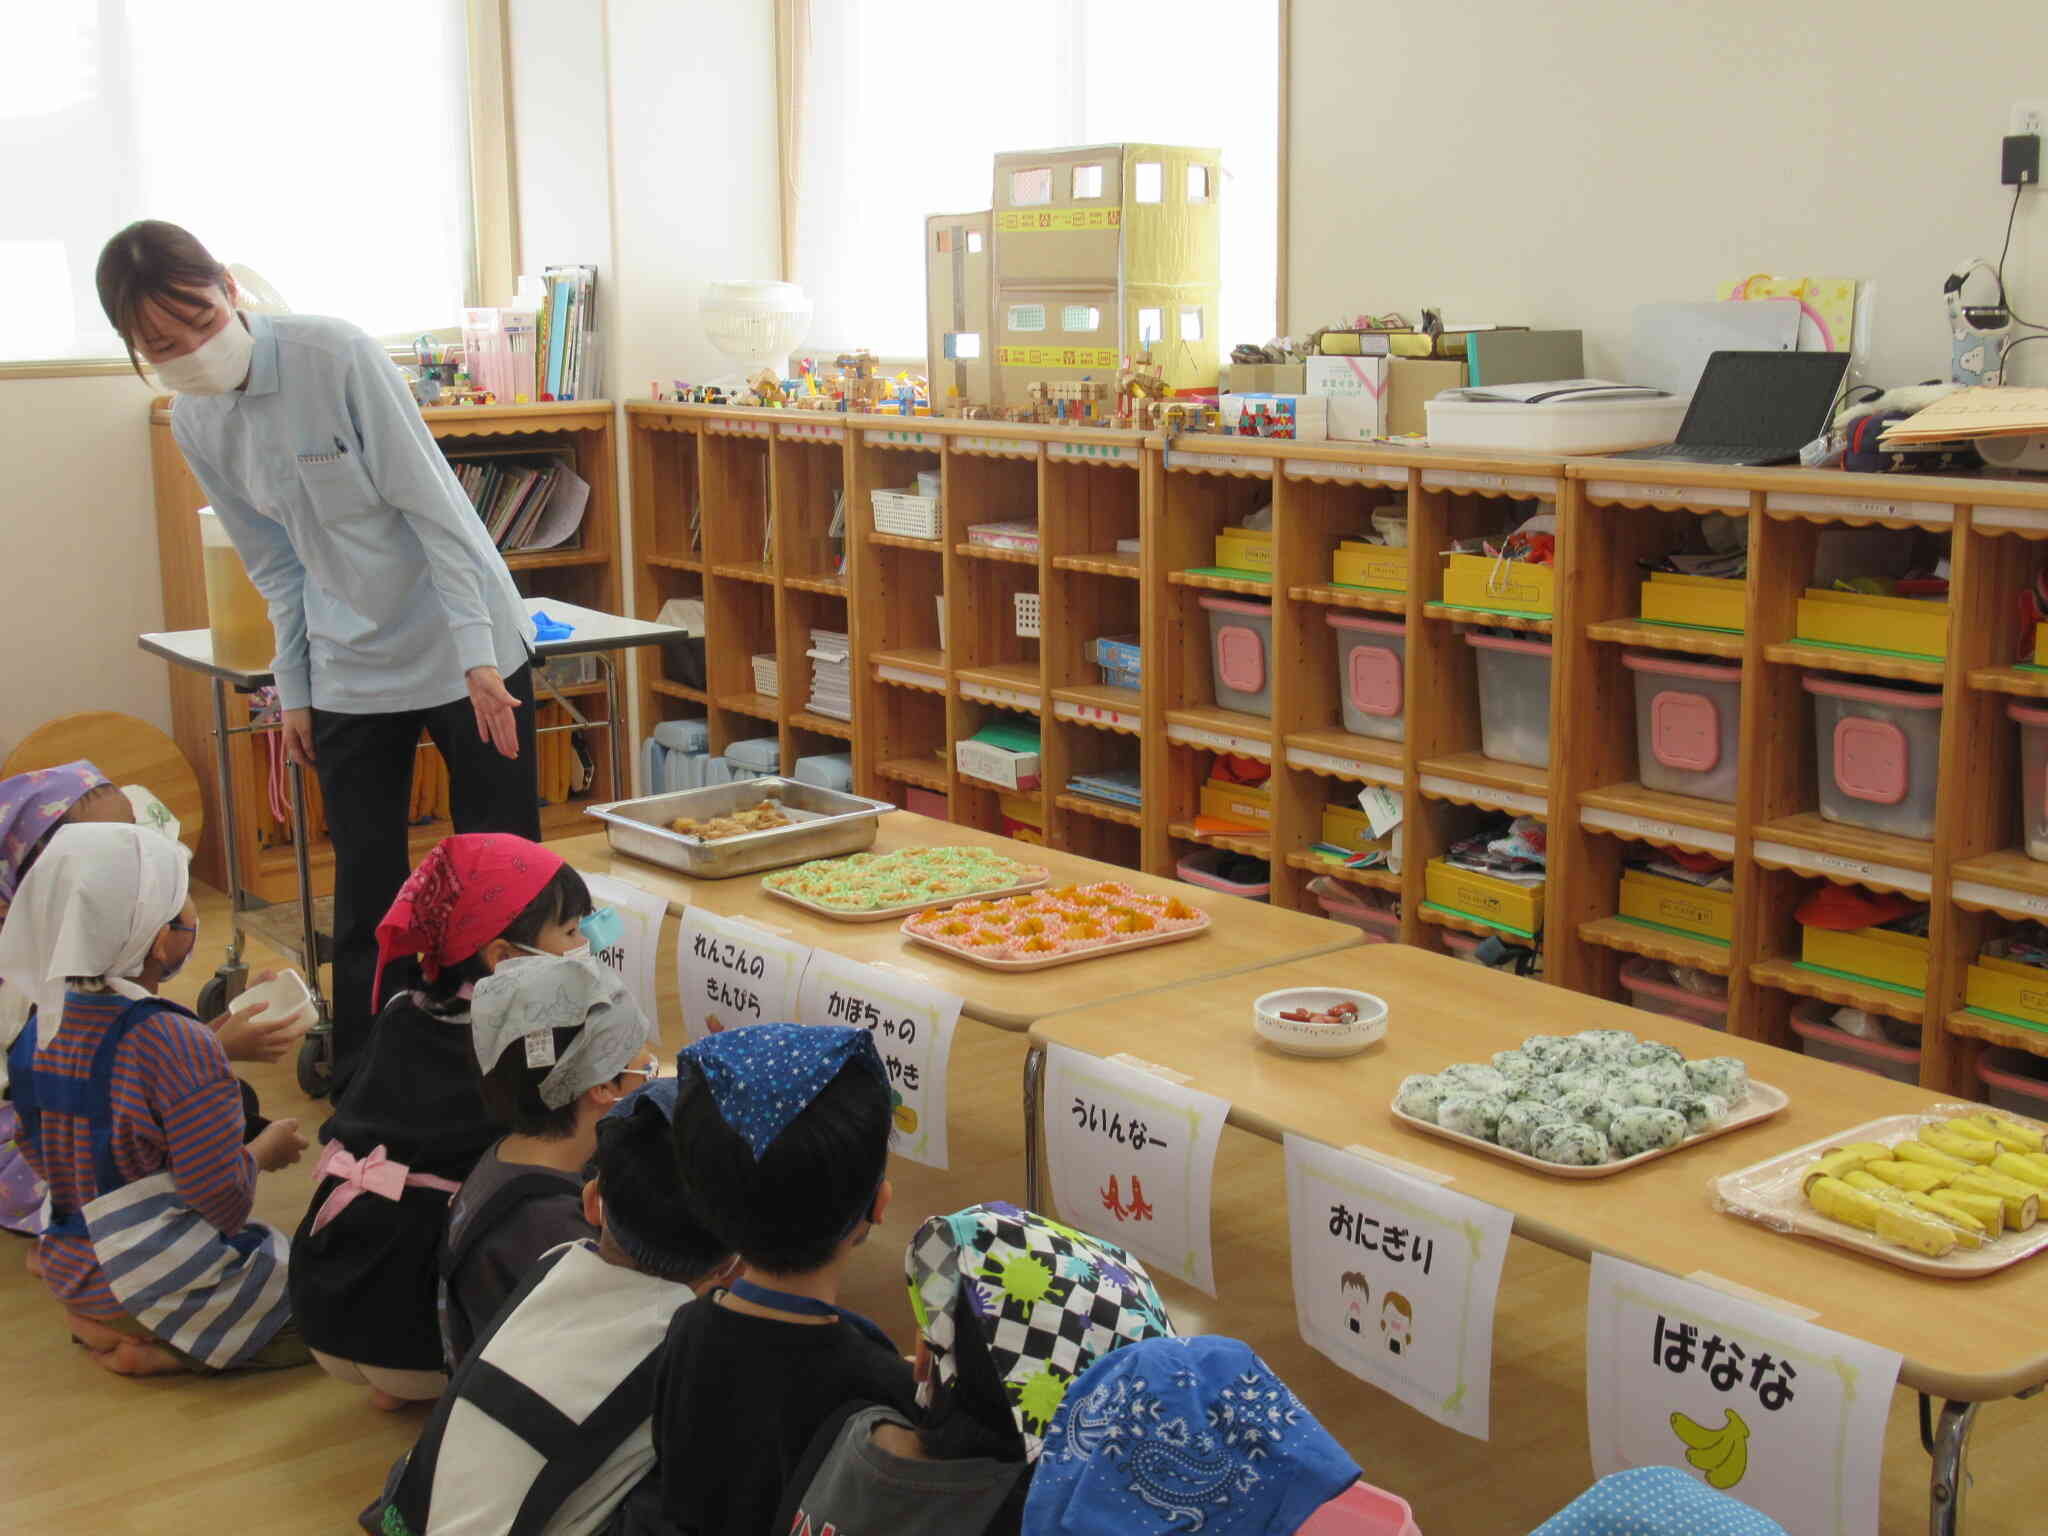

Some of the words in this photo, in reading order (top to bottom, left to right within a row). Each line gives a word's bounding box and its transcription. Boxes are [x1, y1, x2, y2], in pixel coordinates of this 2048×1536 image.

[693, 932, 765, 980] れんこんの
[706, 976, 761, 1019] きんぴら
[827, 990, 916, 1045] かぼちゃの
[885, 1054, 920, 1091] やき
[1071, 1097, 1168, 1151] ういんなー
[1329, 1204, 1434, 1275] おにぎり
[1652, 1314, 1798, 1412] ばなな
